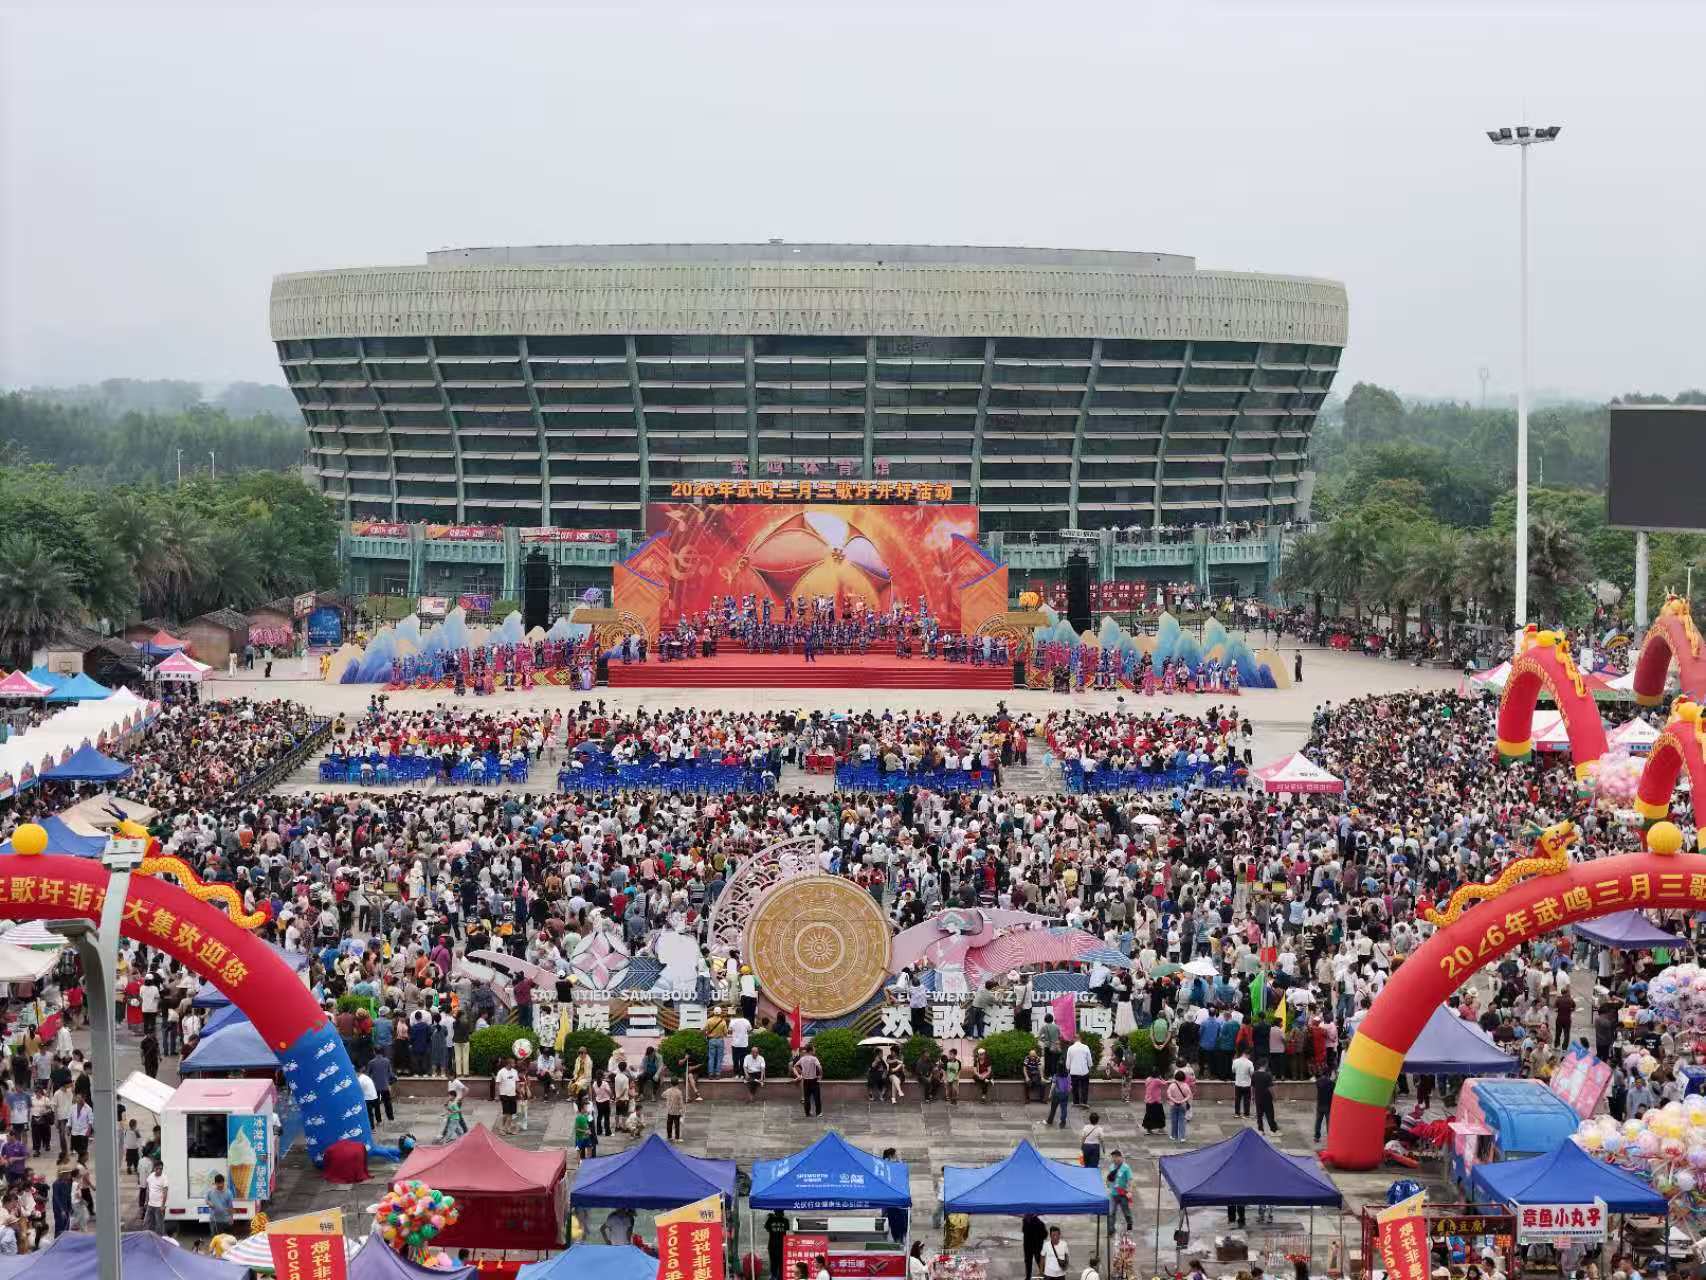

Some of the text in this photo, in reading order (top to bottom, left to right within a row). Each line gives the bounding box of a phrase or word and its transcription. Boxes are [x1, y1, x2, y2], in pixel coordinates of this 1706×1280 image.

[731, 458, 891, 476] 武鸣体育馆
[671, 480, 953, 500] 2026年武鸣三月三歌圩开圩活动
[1522, 1207, 1601, 1228] 章鱼小丸子
